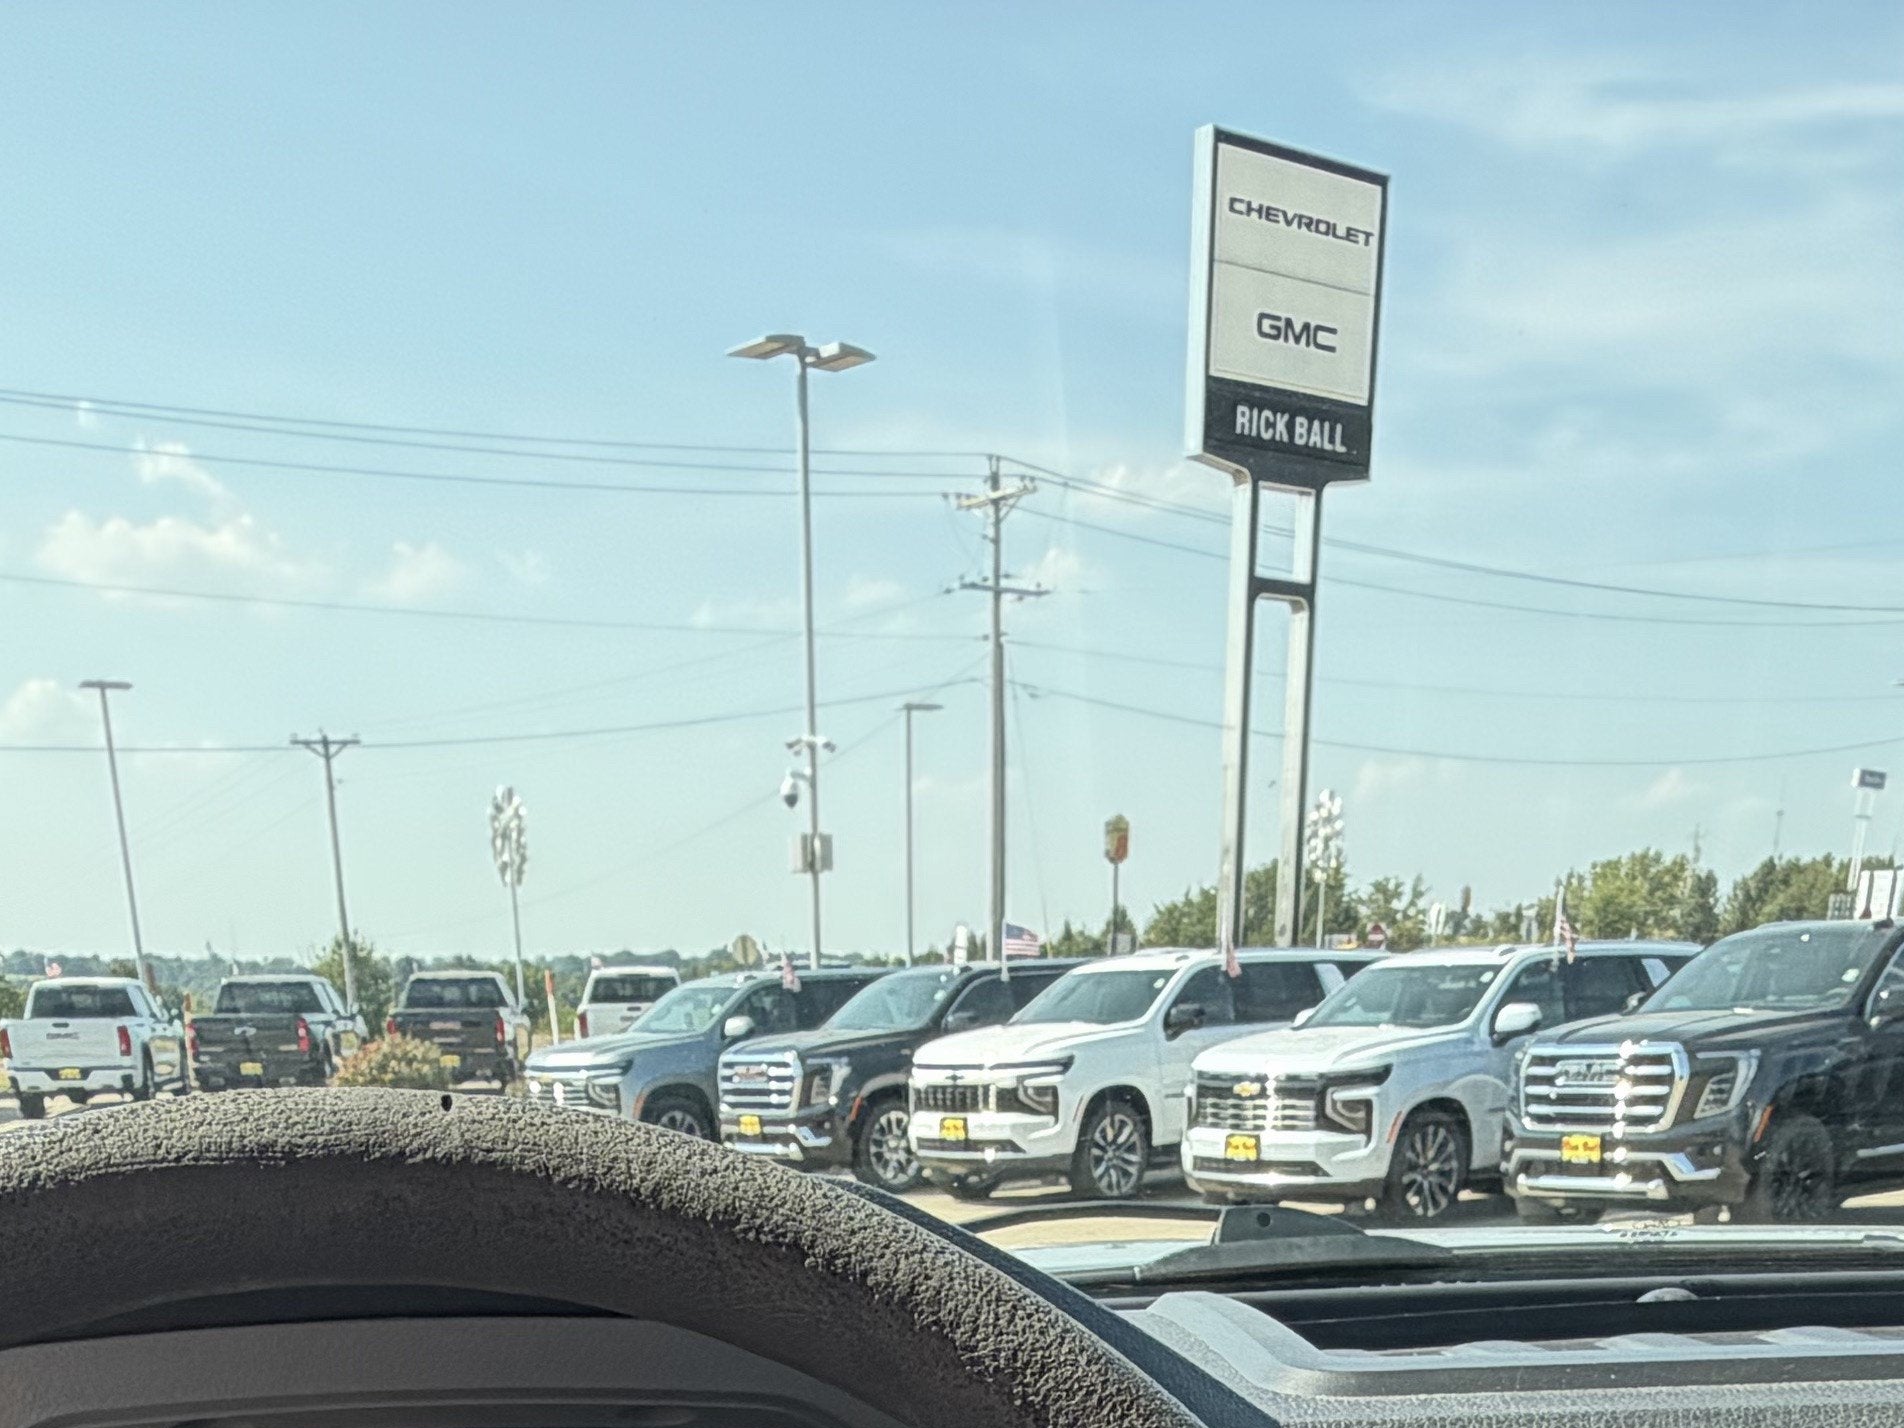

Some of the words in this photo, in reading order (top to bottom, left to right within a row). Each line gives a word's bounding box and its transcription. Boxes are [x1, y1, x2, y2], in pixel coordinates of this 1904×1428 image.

[1228, 196, 1375, 248] CHEVROLET
[1256, 312, 1338, 354] GMC
[1234, 404, 1289, 443] RICK
[1293, 416, 1347, 453] BALL
